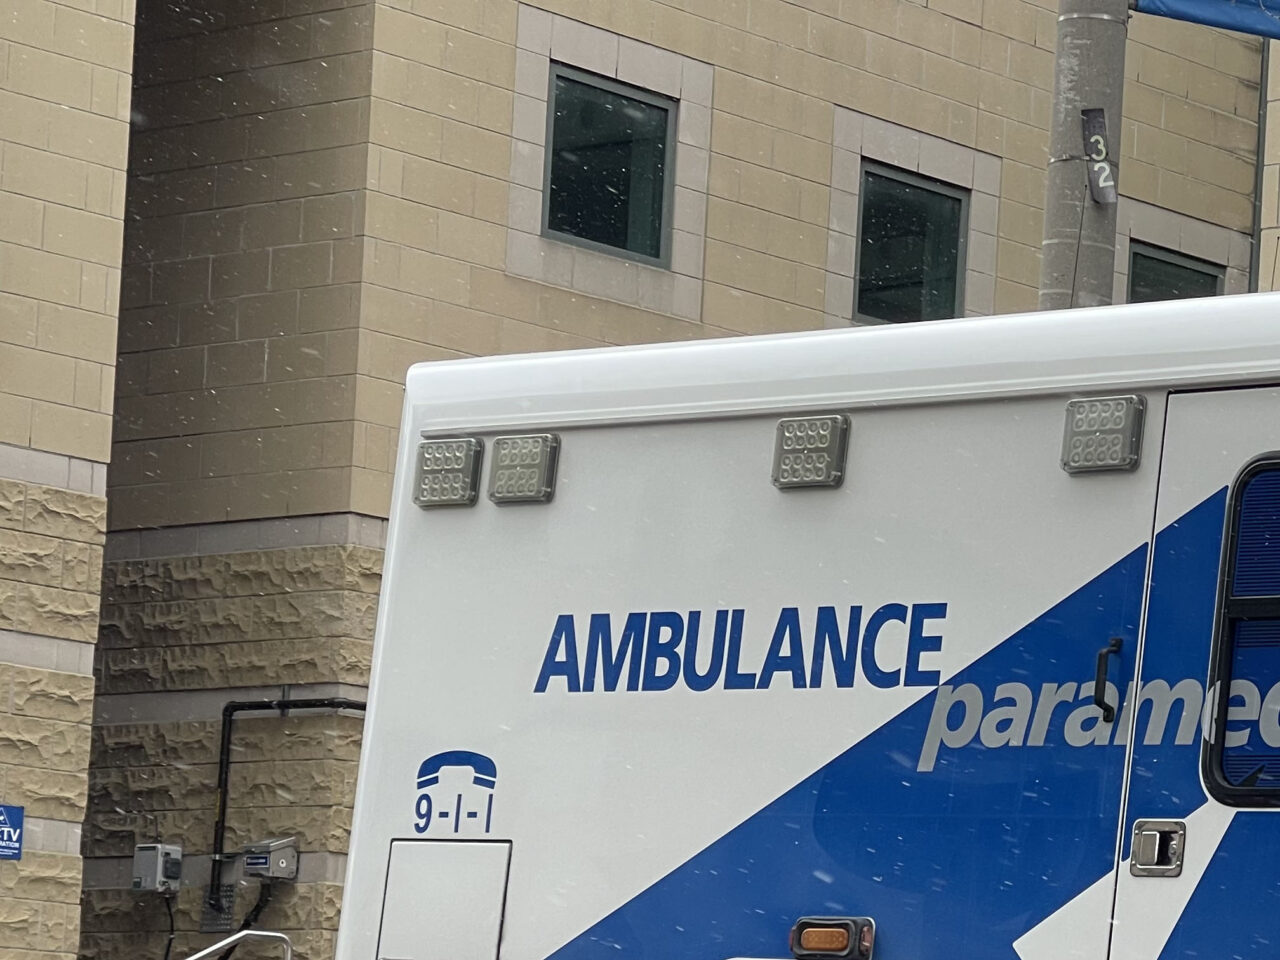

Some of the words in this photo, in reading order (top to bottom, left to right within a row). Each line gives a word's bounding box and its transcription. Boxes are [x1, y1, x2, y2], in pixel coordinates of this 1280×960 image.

[1090, 134, 1115, 188] 32
[533, 601, 948, 694] AMBULANCE
[0, 827, 20, 841] TV
